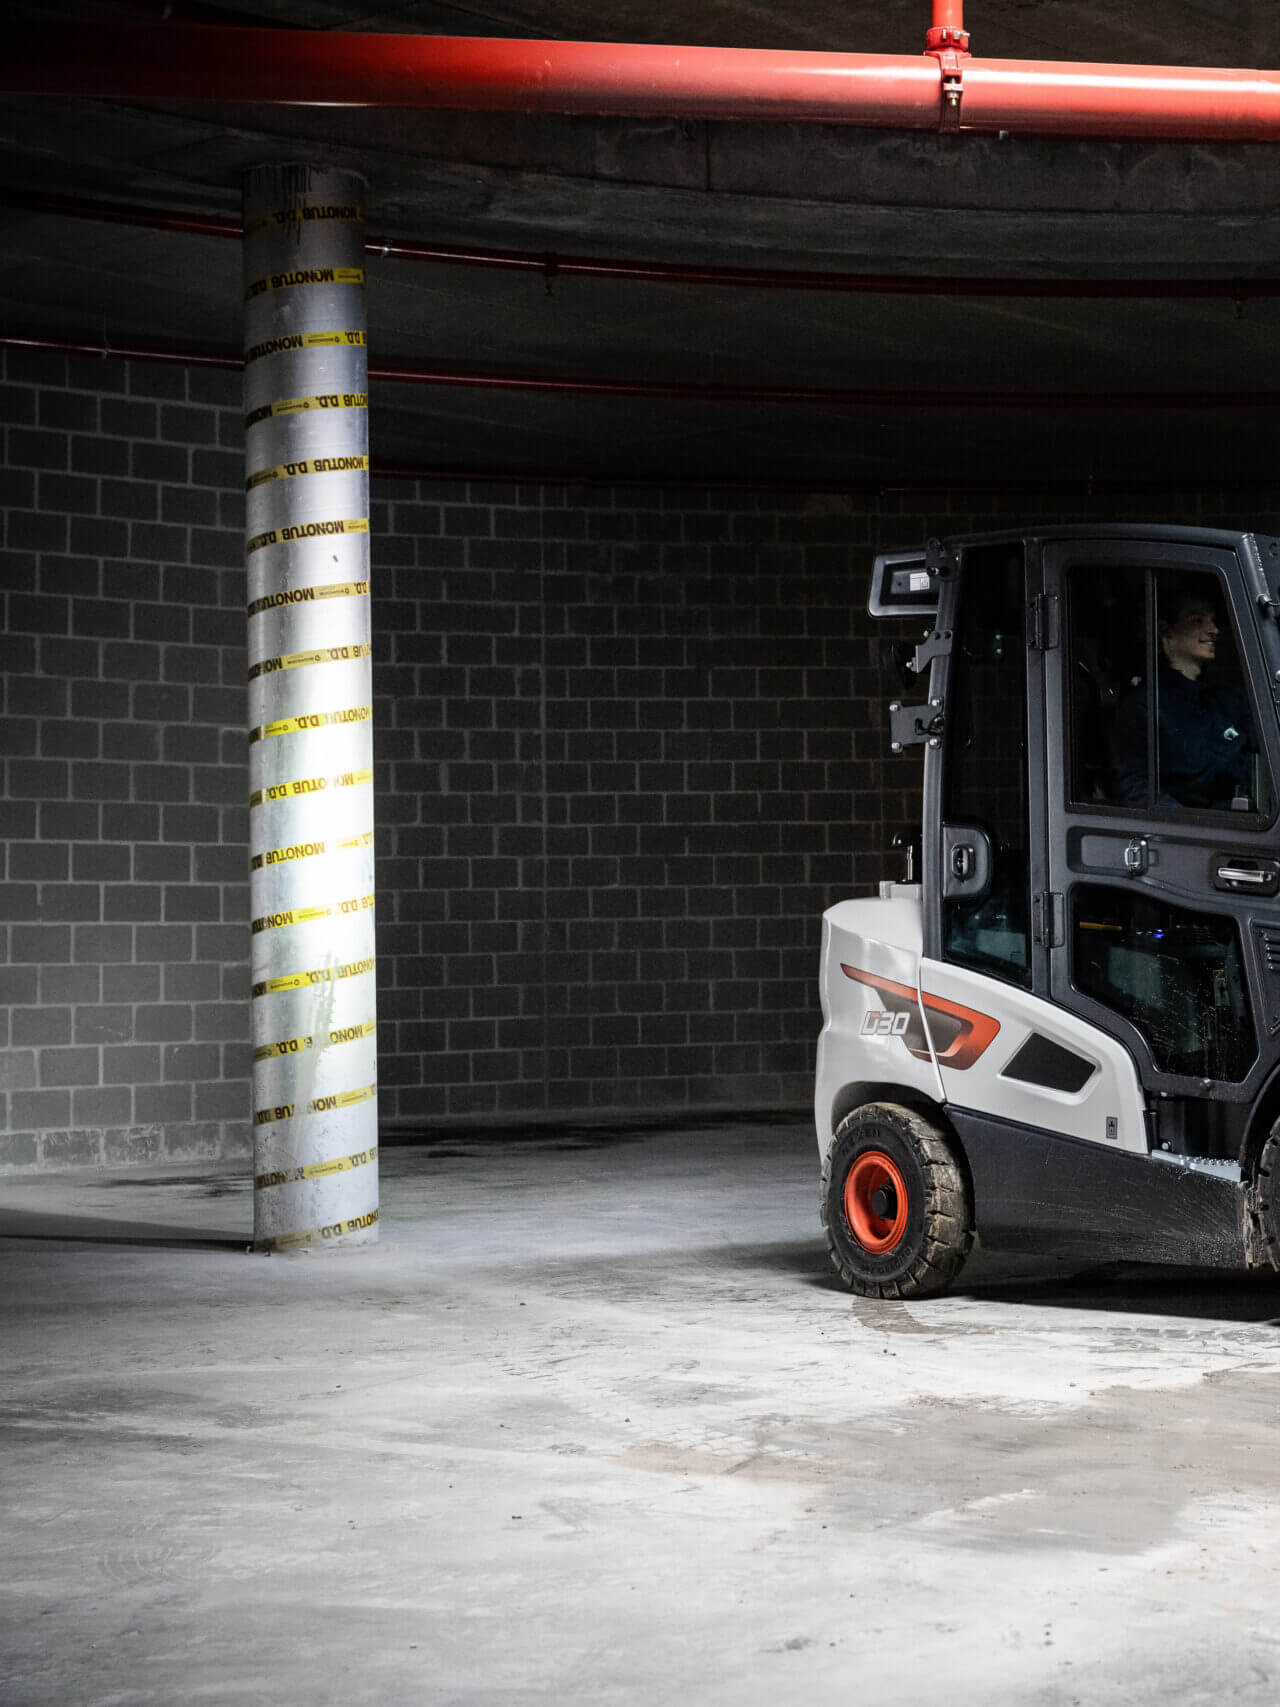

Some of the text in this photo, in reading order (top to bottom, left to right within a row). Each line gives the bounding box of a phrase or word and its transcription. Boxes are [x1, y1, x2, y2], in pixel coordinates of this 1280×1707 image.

[271, 269, 334, 289] MONOTUB
[315, 394, 339, 408] D.D.
[283, 456, 364, 476] MONOTUB D.D.
[281, 520, 345, 541] MONOTUB
[327, 647, 349, 661] D.D.
[294, 715, 319, 729] D.D.
[265, 842, 325, 865] MONOTUB
[276, 1039, 298, 1054] D.D.
[317, 1223, 342, 1239] D.D.
